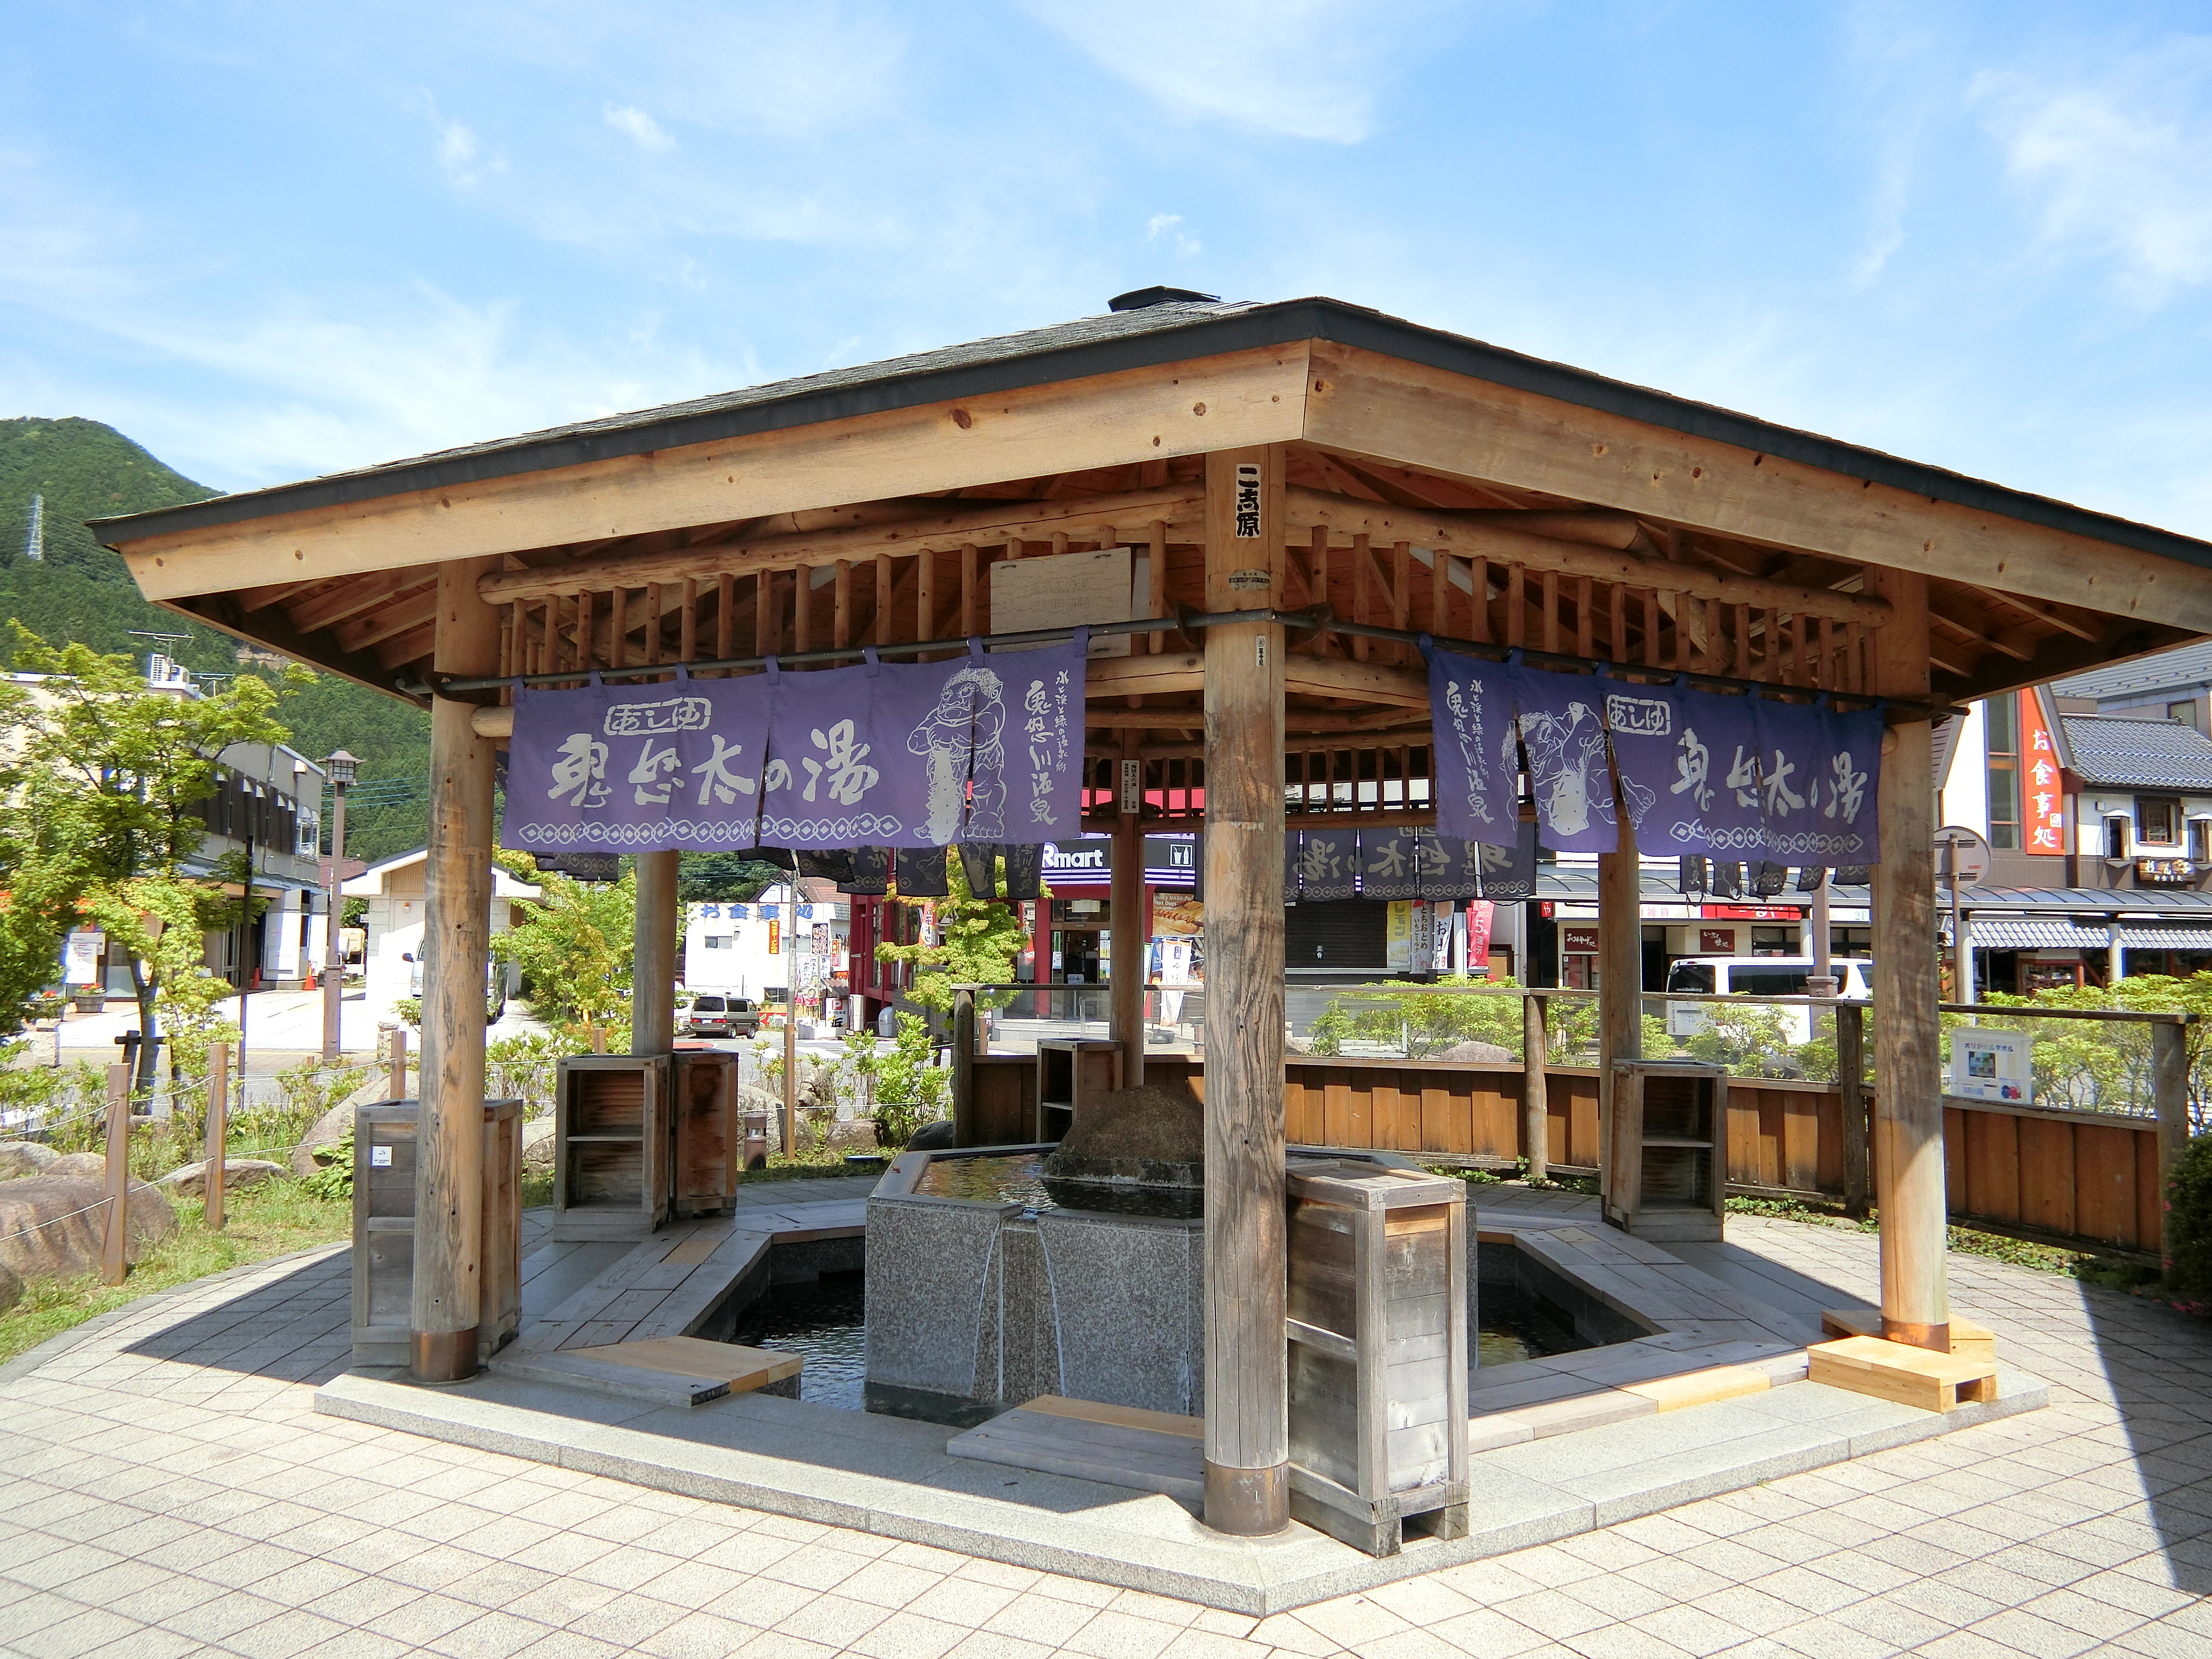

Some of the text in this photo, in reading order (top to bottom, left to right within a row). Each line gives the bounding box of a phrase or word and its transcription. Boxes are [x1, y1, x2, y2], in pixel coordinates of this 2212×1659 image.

[548, 719, 879, 808] 鬼怒太の湯
[1024, 680, 1058, 825] 鬼怒川温泉
[1446, 680, 1495, 824] 鬼怒川温泉
[2030, 729, 2056, 848] お食事処
[833, 1000, 842, 1010] P
